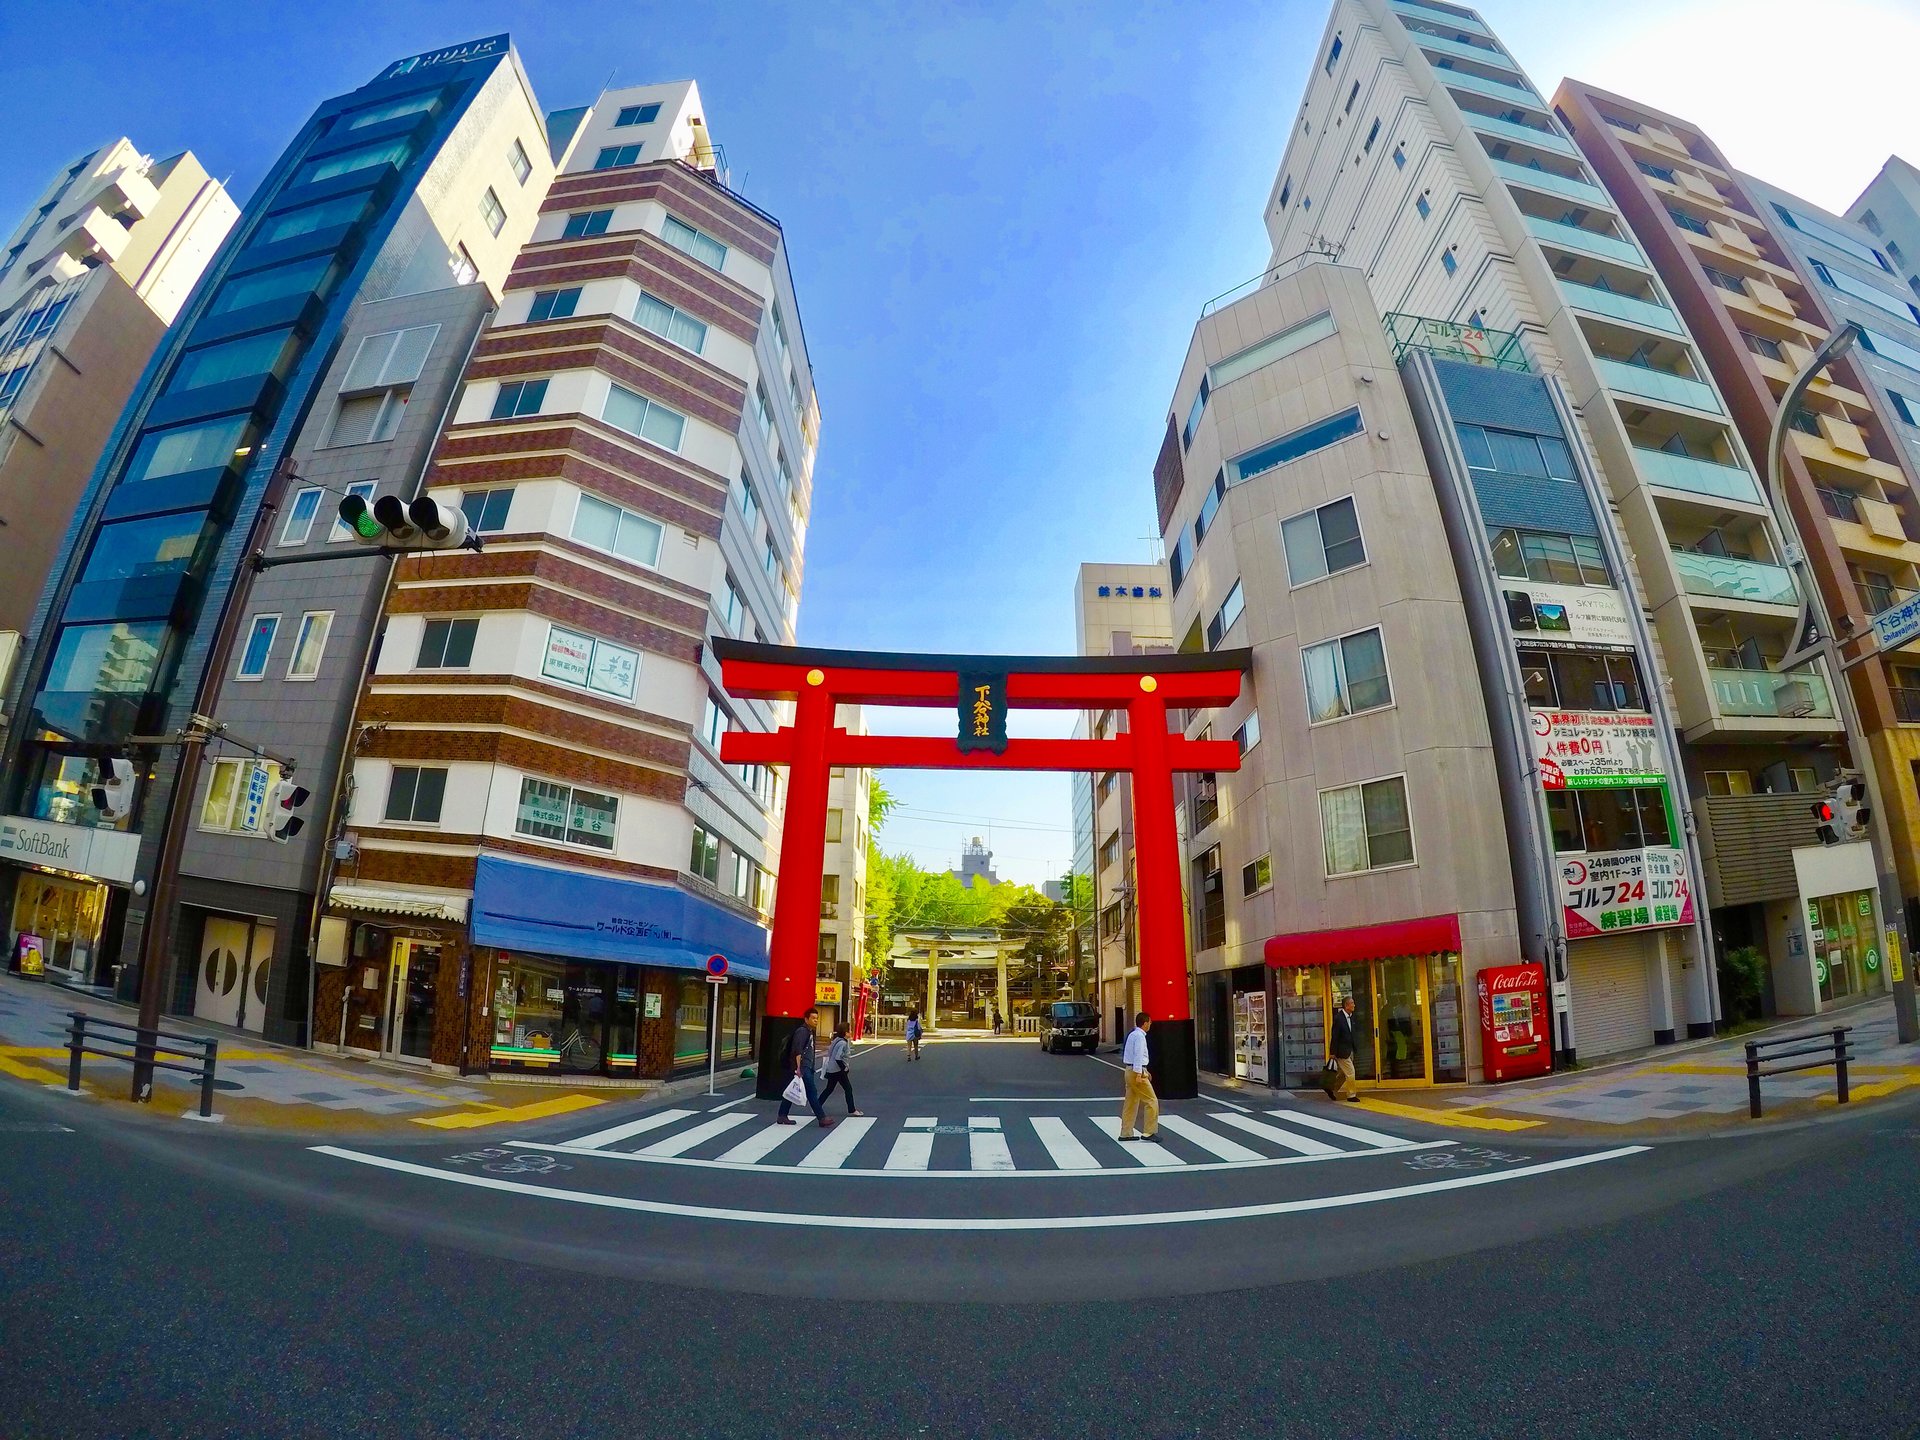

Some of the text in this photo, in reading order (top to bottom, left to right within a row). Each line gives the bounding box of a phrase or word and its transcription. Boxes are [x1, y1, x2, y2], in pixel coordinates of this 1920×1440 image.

[1098, 586, 1162, 598] 鈴木歯科
[1577, 599, 1616, 611] SKYTRAK
[556, 637, 584, 650] ふくしま
[973, 685, 992, 736] 下谷神社
[533, 809, 562, 823] 株式会社
[17, 829, 71, 859] SoftBank
[1588, 854, 1641, 869] 24時間OPEN
[1568, 880, 1646, 909] ゴルフ24
[1652, 879, 1688, 899] ゴルフ24
[1600, 906, 1650, 930] 練習場
[1655, 904, 1679, 922] 練習場
